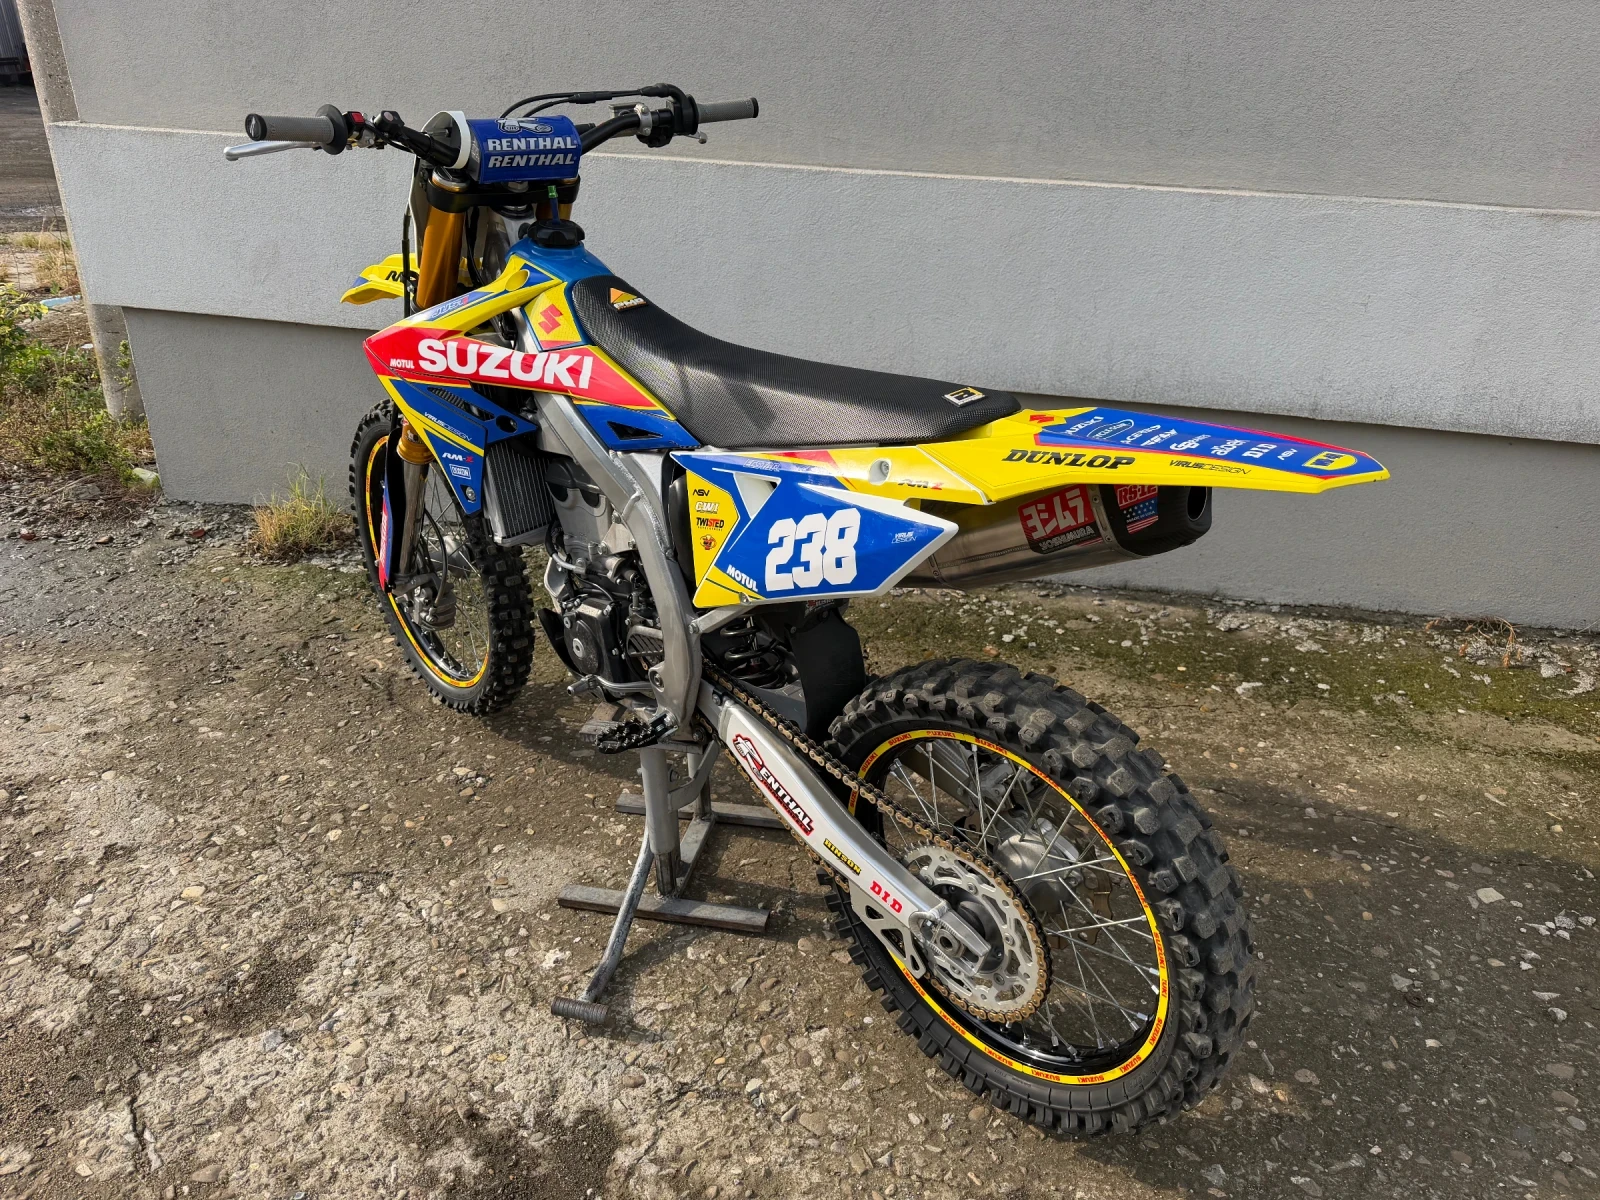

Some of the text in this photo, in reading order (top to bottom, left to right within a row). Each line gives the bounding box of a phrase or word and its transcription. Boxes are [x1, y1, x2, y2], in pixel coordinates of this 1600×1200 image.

[487, 136, 577, 151] RENTHAL
[488, 153, 575, 168] RENTHAL
[390, 358, 415, 369] MOTUL
[418, 338, 593, 389] SUZUKI
[1002, 448, 1136, 470] DUNLOP
[692, 488, 710, 497] ASV
[696, 517, 725, 529] TWISTED
[1039, 525, 1095, 551] YOSHIMURA
[765, 507, 861, 592] 238
[726, 564, 759, 593] MOTUL
[888, 733, 912, 746] SUZUKI
[861, 752, 878, 772] SUZUKI
[823, 838, 861, 876] HINSON
[1148, 1017, 1162, 1046] SUZUKI
[1119, 1054, 1142, 1073] SUZUKI
[1031, 1069, 1060, 1081] SUZUKI
[1077, 1075, 1104, 1083] SUZUKI
